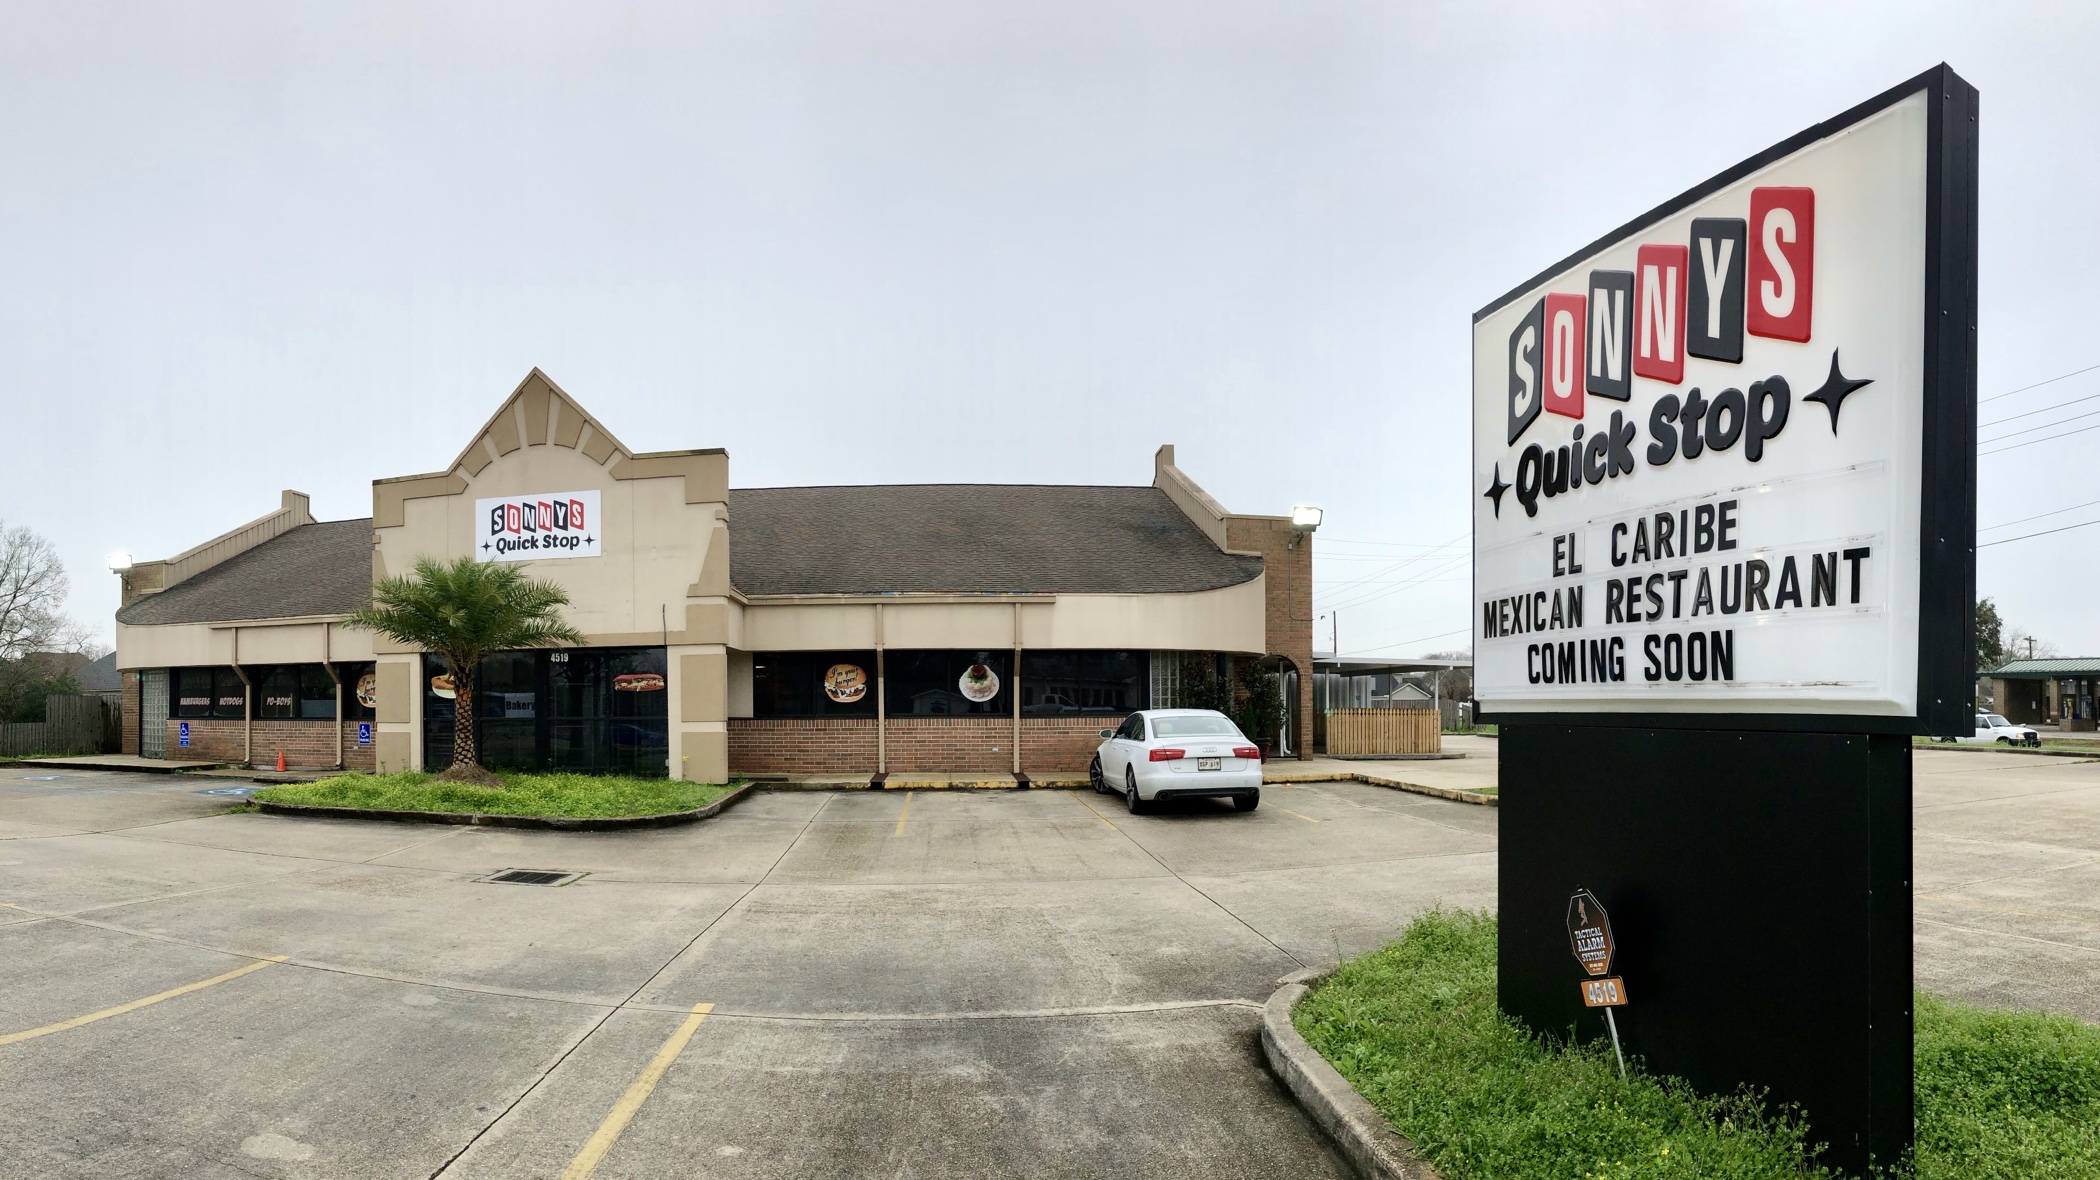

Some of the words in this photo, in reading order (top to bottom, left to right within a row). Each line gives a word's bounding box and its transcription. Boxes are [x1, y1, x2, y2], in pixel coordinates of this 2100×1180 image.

[1513, 206, 1798, 419] SONNYS
[1516, 409, 1636, 518] Quick
[1647, 375, 1791, 463] Stop
[493, 503, 582, 532] SONNYS
[496, 535, 539, 555] Quick
[542, 534, 580, 550] Stop
[1553, 532, 1582, 578] EL
[1611, 499, 1738, 567] CARIBE
[1483, 585, 1583, 639] MEXICAN
[1605, 547, 1870, 625] RESTAURANT
[550, 653, 569, 663] 4519
[1527, 636, 1625, 684] COMING
[1644, 629, 1734, 682] SOON
[219, 697, 243, 706] HOTDOGS
[266, 697, 291, 706] PO-BOYS
[1574, 927, 1603, 940] TACTICAL
[1577, 936, 1606, 952] ALARM
[1581, 951, 1607, 962] SYSTEMS
[1588, 981, 1618, 1004] 4519
